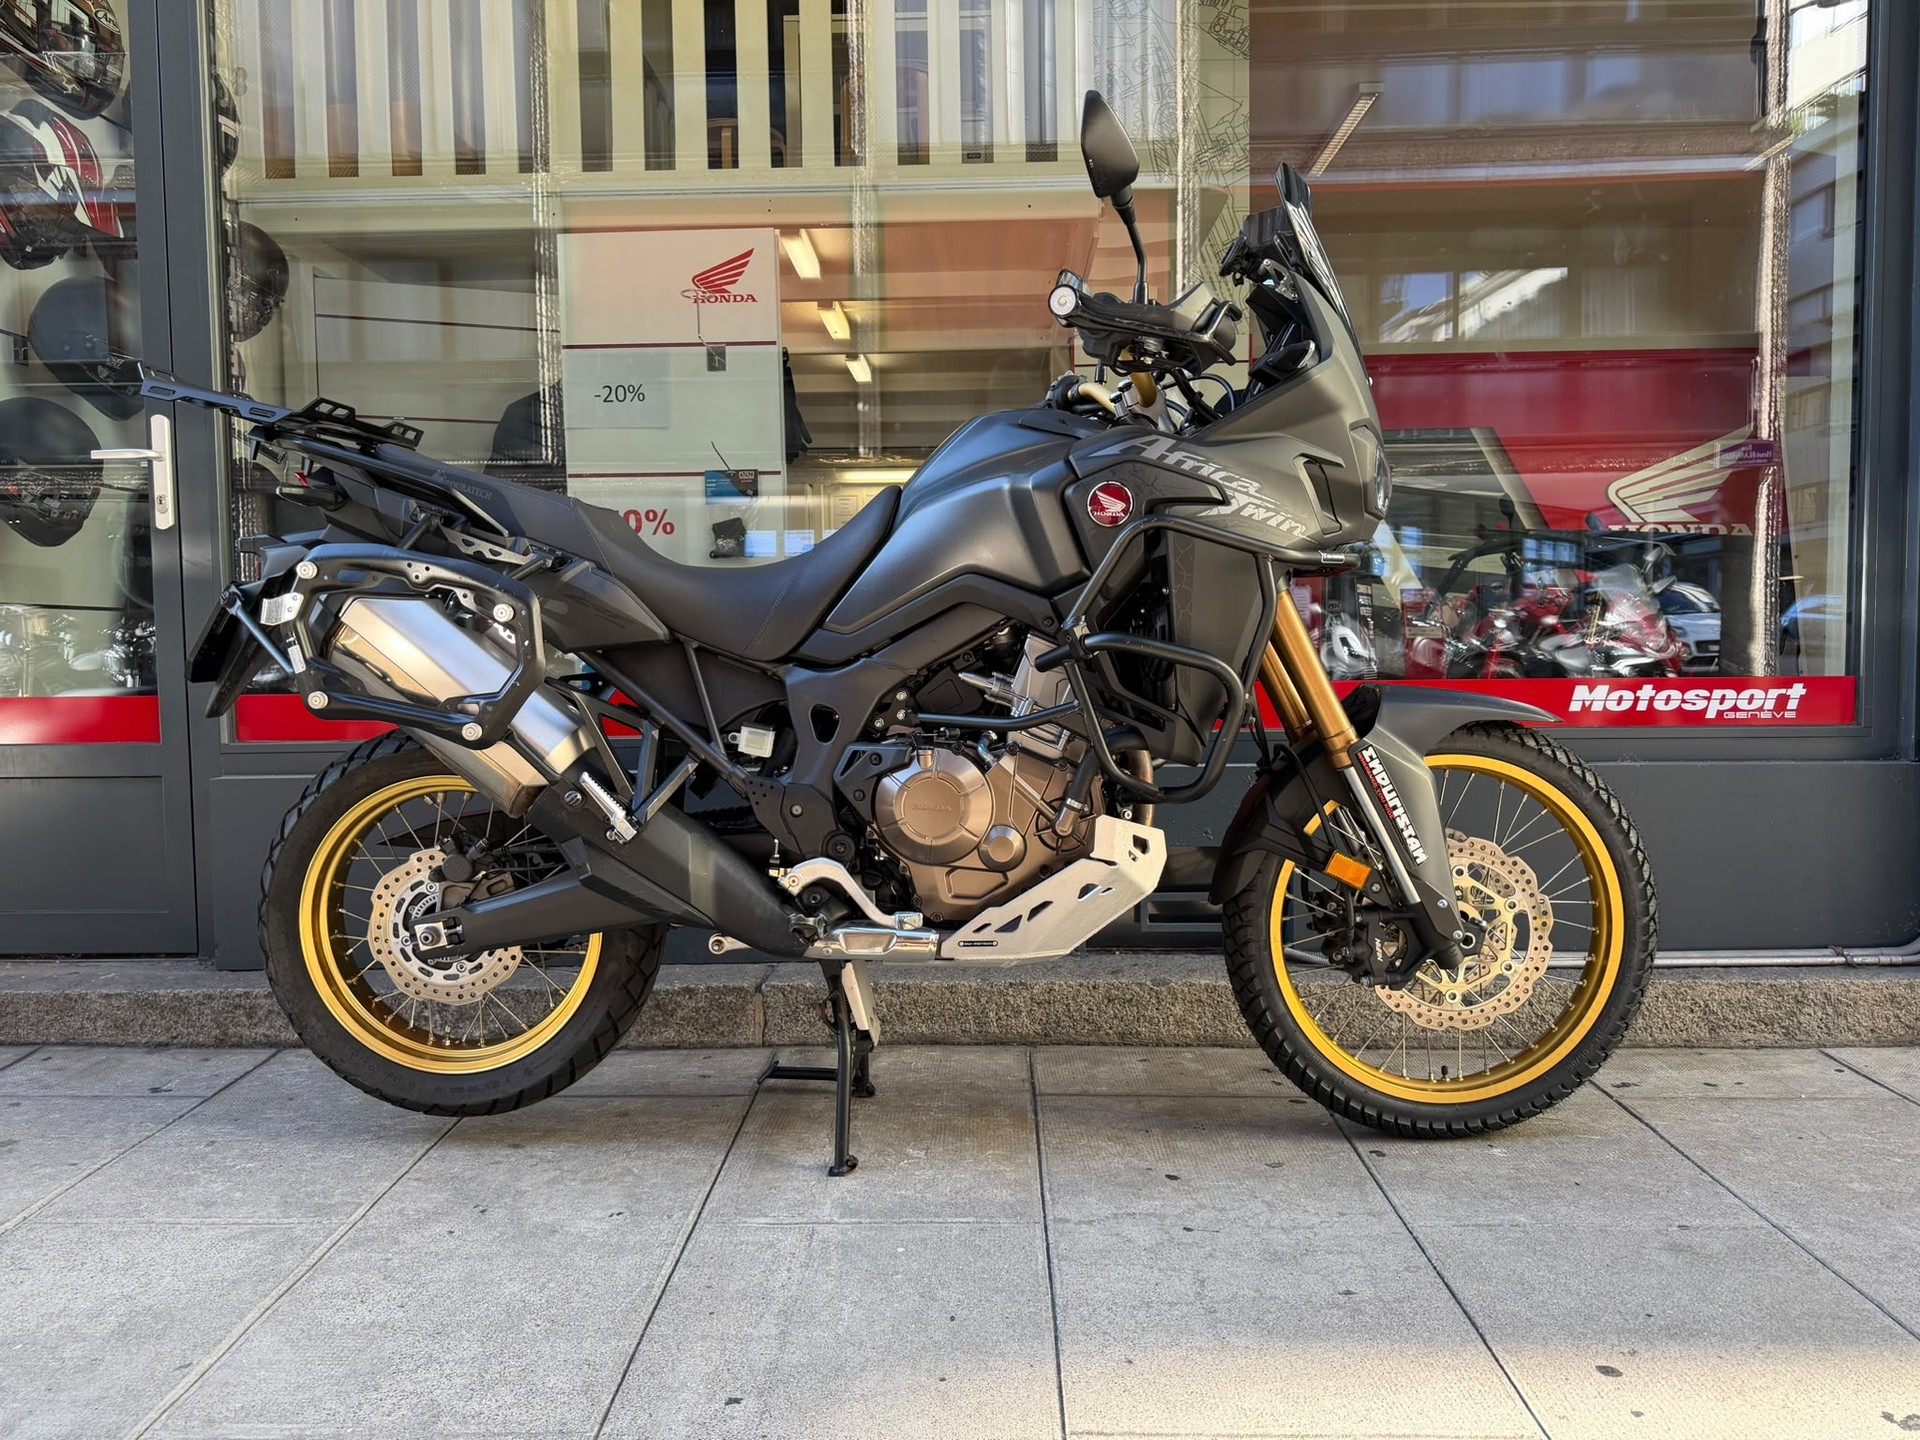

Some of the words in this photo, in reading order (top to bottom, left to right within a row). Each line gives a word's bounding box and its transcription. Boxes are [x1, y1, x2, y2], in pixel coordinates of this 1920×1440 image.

[693, 294, 758, 304] HONDA
[594, 384, 645, 402] -20%
[617, 508, 675, 535] 0%
[1568, 683, 1807, 719] Motosport
[1361, 745, 1429, 867] ENDURISTAN
[1384, 803, 1396, 821] RIDE
